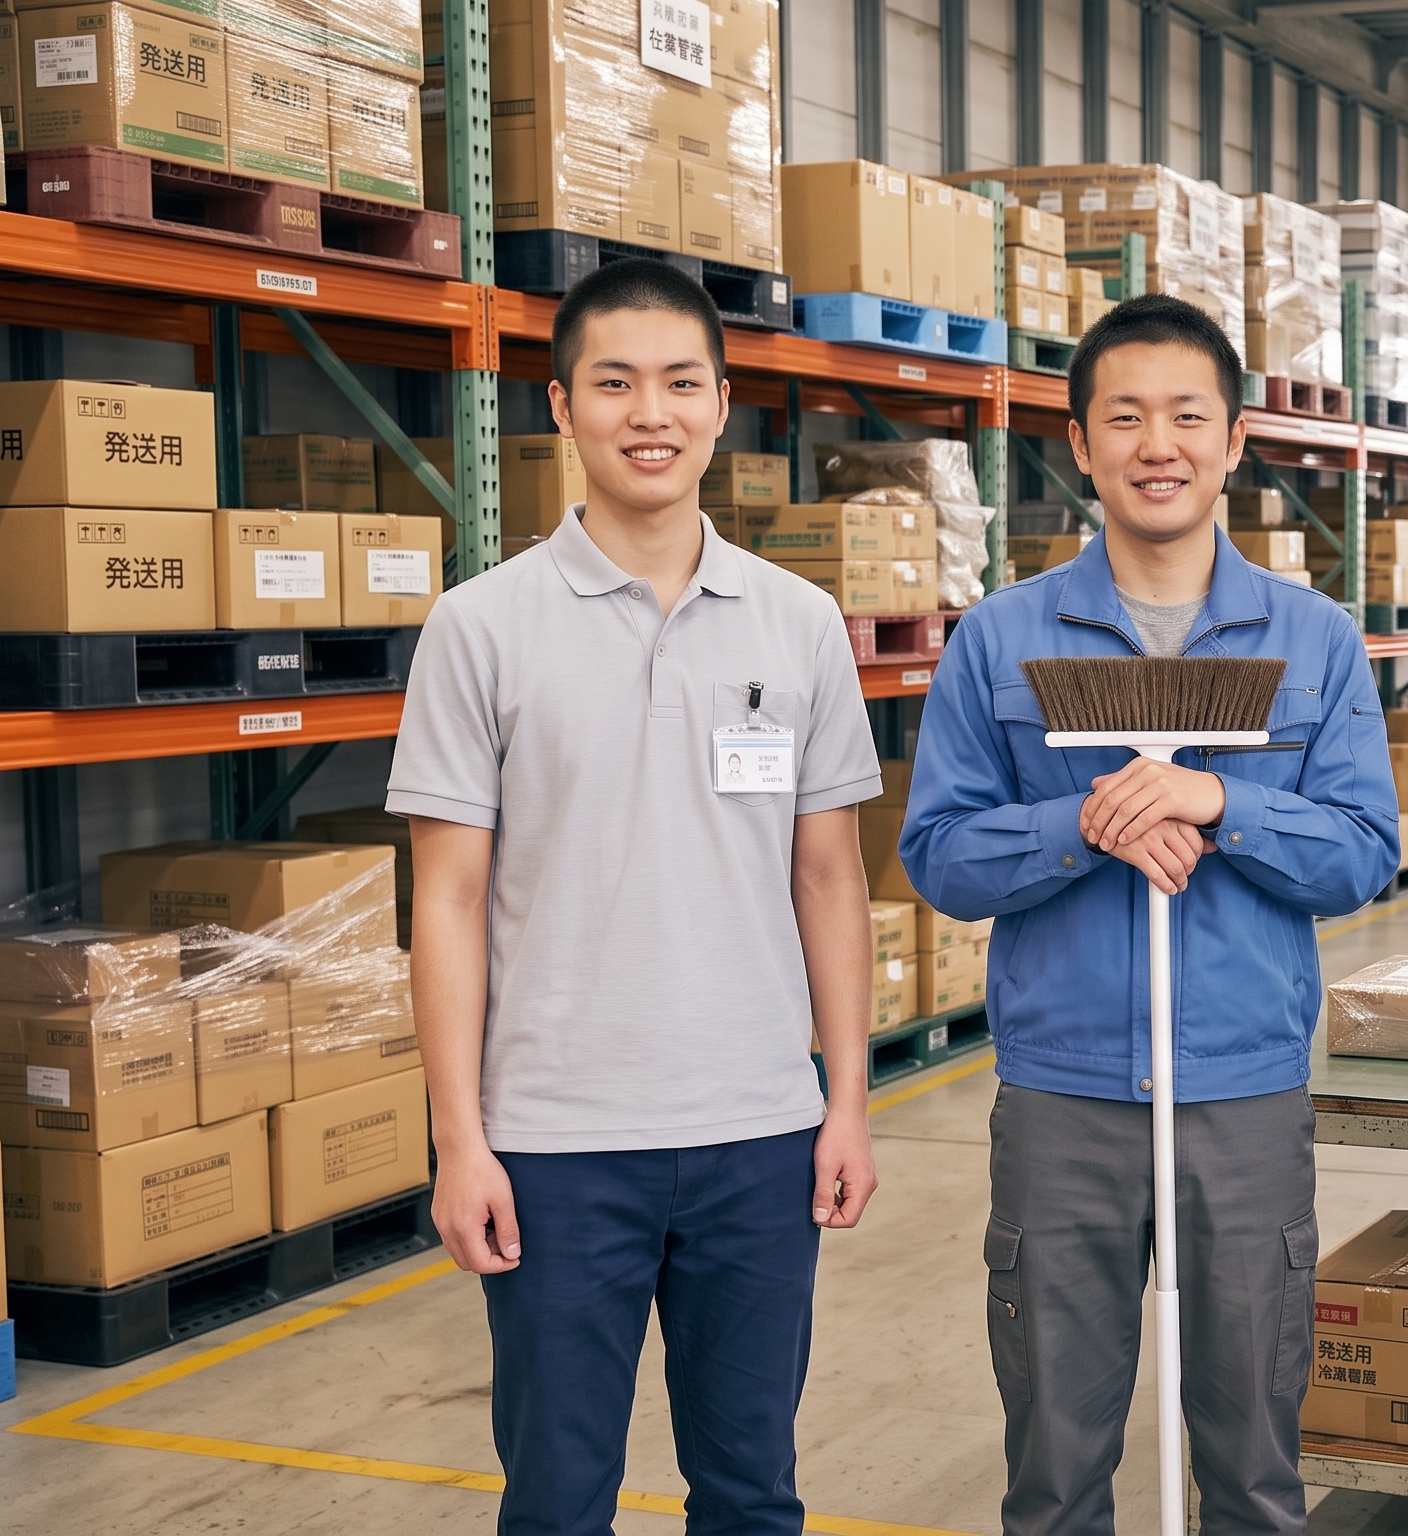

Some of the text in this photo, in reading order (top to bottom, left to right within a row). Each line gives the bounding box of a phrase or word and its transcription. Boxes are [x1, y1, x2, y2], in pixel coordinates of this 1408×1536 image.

[140, 41, 206, 83] 発送用
[105, 431, 183, 466] 発送用
[105, 557, 184, 589] 発送用
[1318, 1340, 1372, 1365] 発送用
